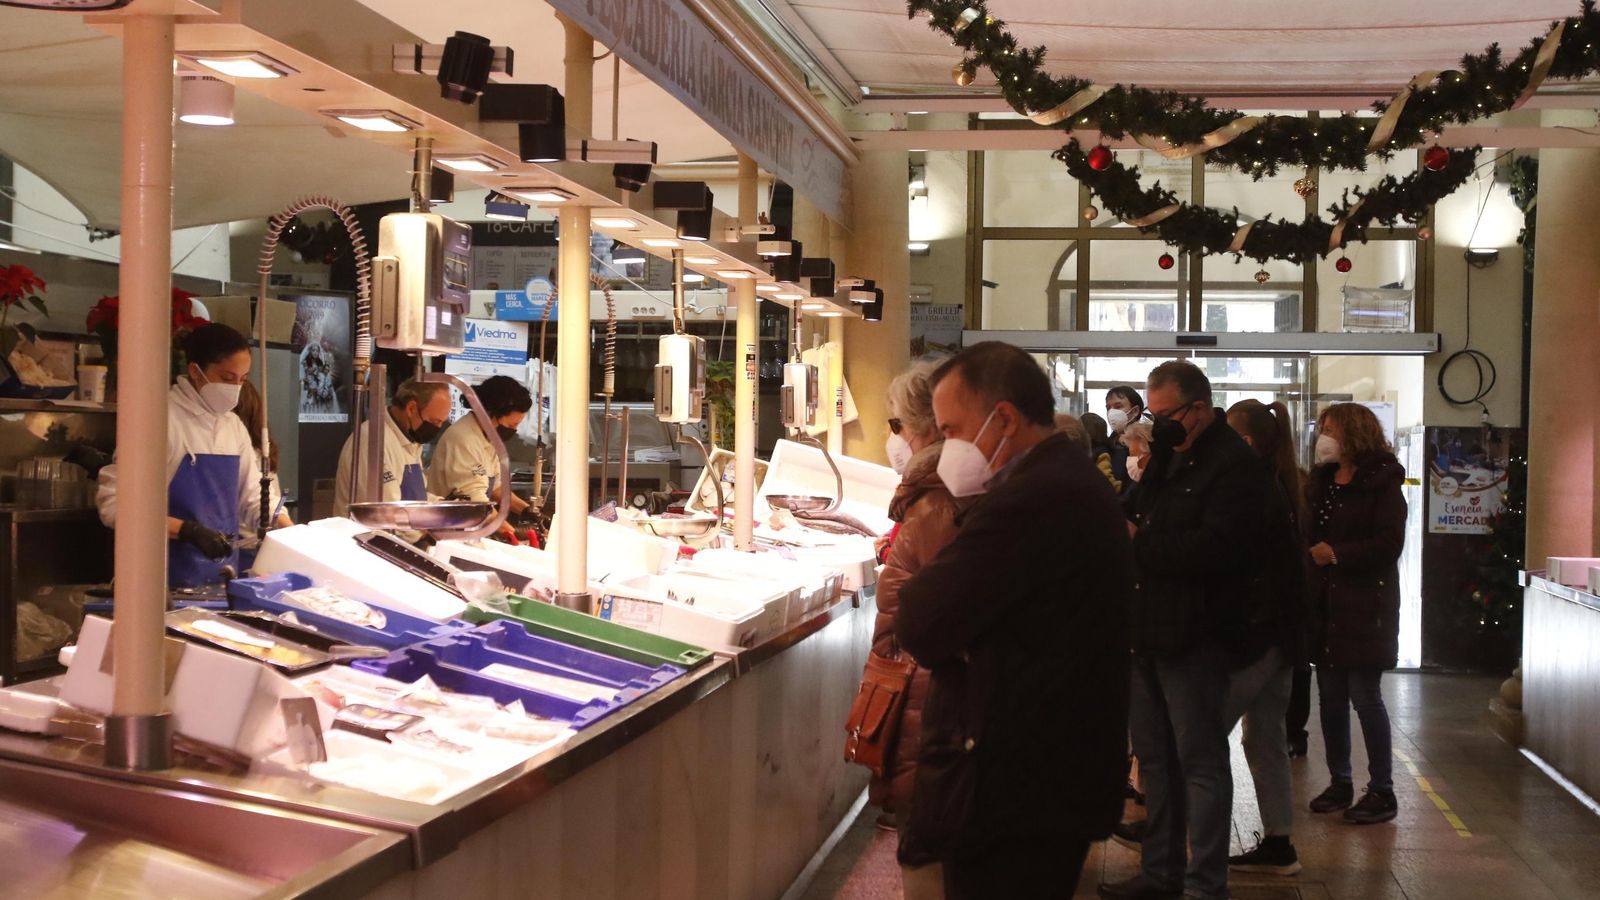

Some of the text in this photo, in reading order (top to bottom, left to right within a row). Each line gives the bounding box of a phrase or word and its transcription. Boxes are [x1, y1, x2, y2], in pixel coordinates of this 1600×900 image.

[587, 0, 697, 97] CADERIA
[477, 327, 517, 340] Viedma
[1438, 515, 1488, 525] MERCAD
